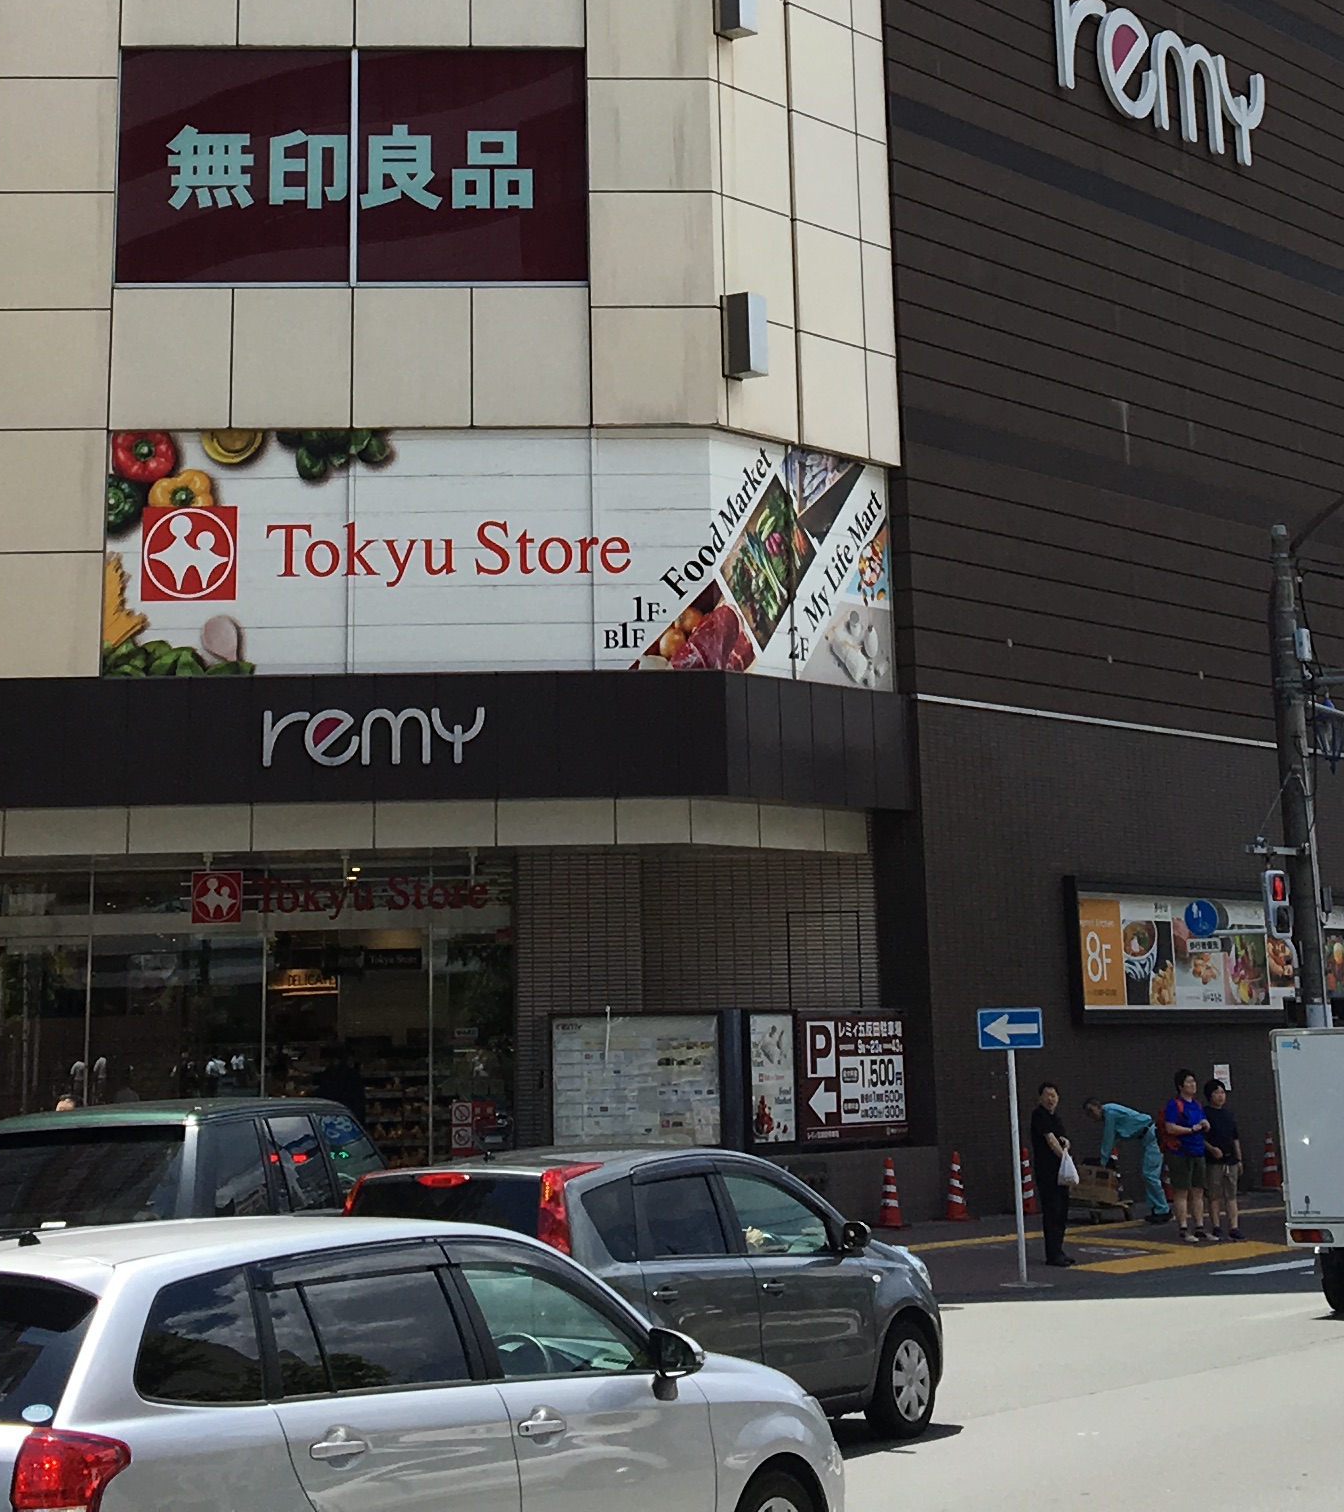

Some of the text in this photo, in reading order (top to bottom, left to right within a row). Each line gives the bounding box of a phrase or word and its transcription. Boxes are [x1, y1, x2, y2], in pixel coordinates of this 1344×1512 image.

[165, 123, 535, 211] 無印良品
[264, 519, 633, 588] Tokyu Store
[658, 445, 774, 601] Food Market
[801, 488, 884, 634] My Life Mart
[603, 622, 646, 650] B1F
[261, 704, 486, 769] remy
[257, 874, 489, 921] Tokyu Store
[1086, 930, 1113, 984] 8F
[859, 1057, 904, 1089] 1,500円
